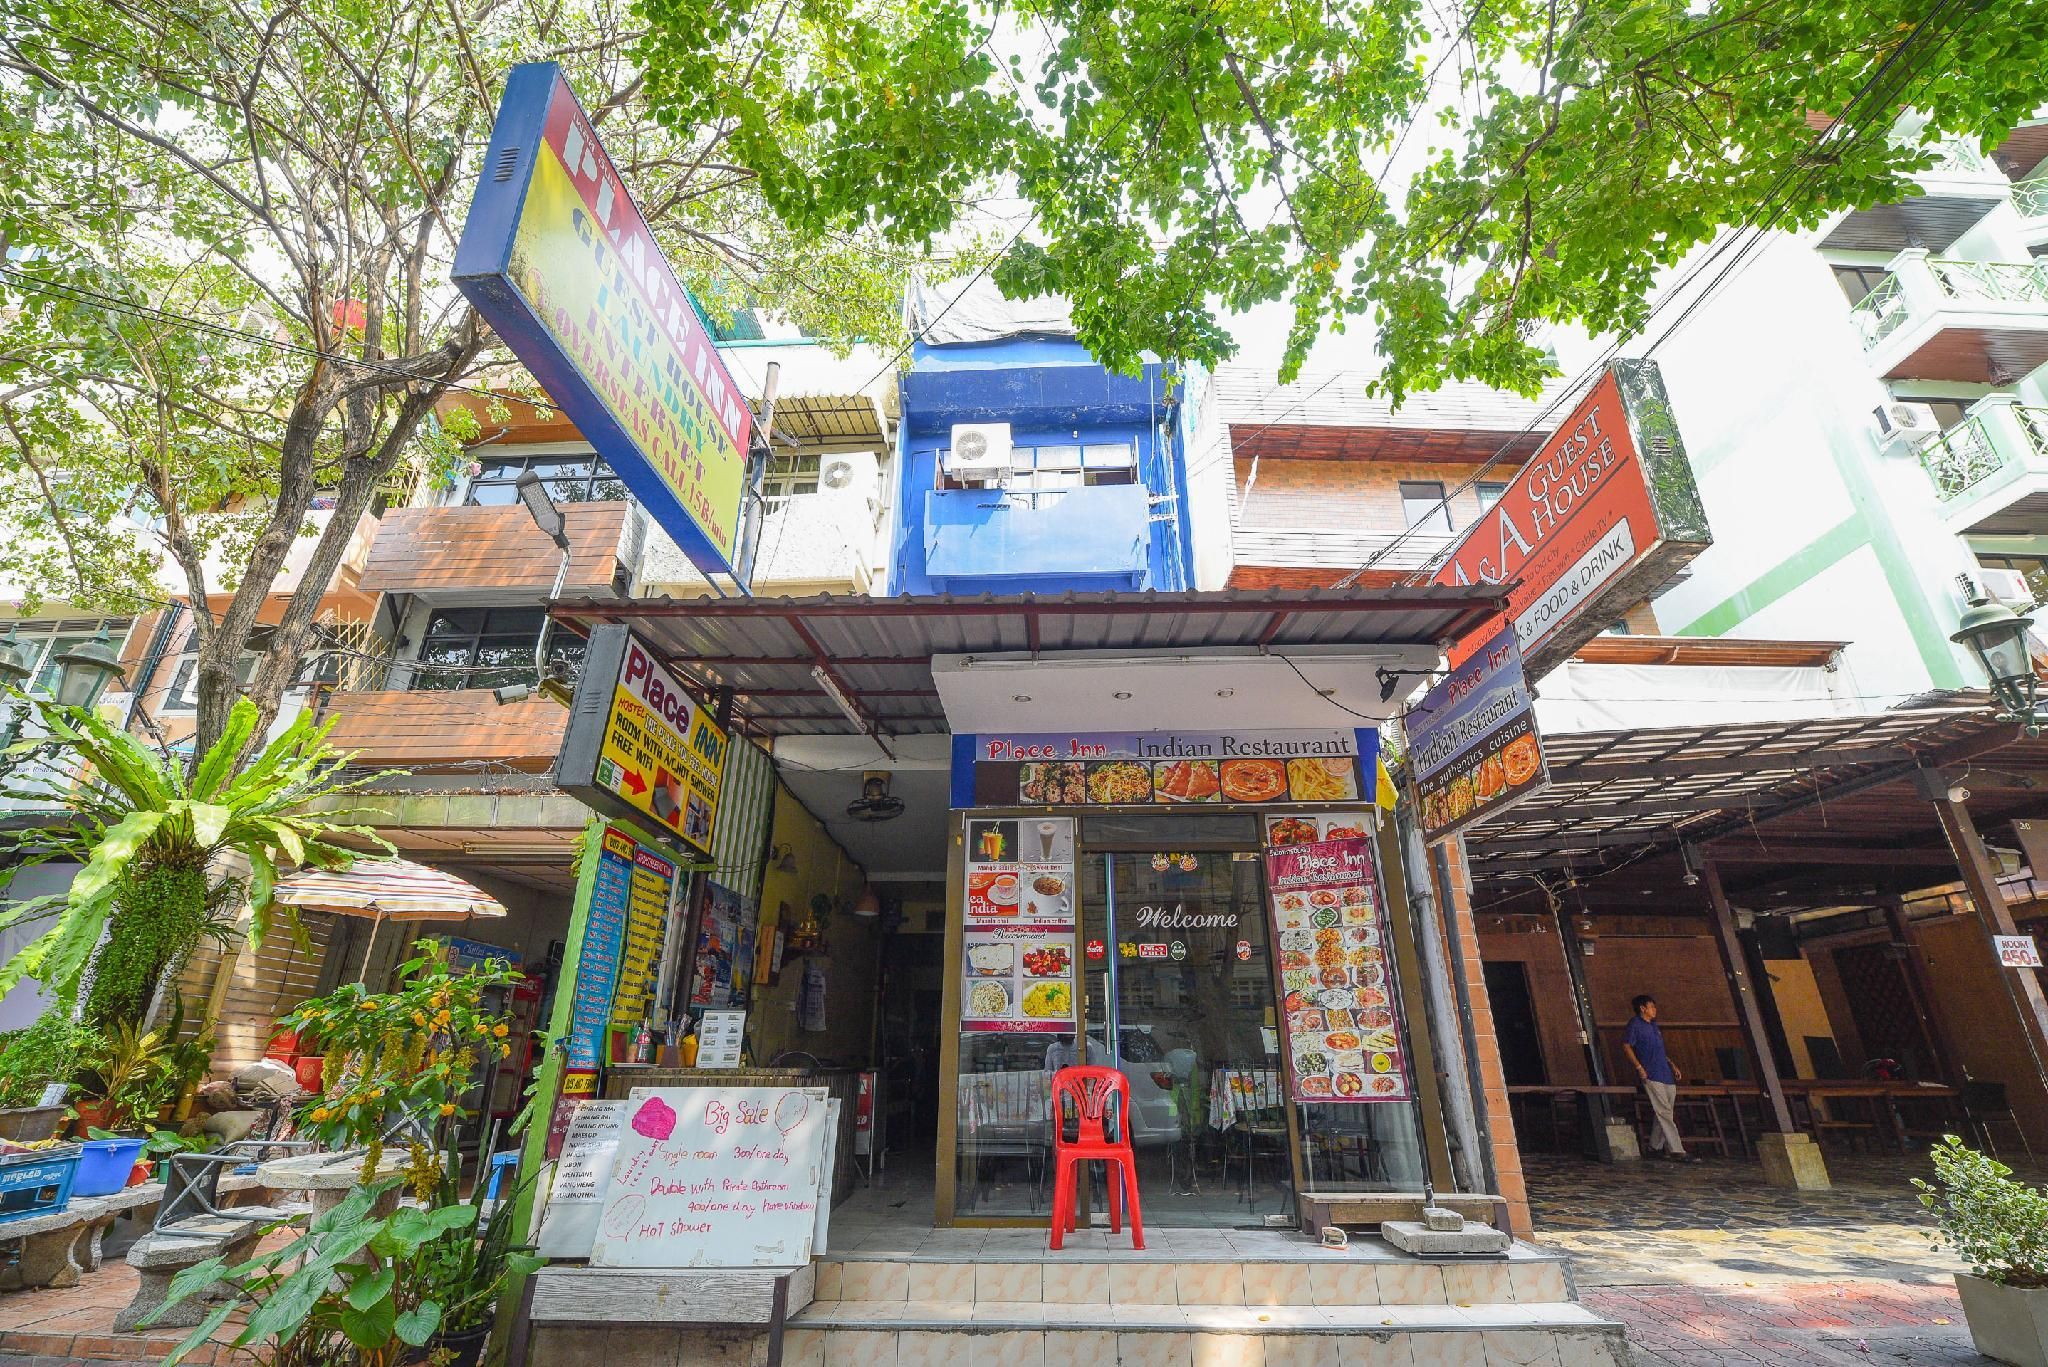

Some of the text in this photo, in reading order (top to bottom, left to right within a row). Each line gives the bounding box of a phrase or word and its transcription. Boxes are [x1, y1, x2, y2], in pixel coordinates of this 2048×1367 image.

[563, 117, 743, 443] PLACE INN
[572, 206, 728, 463] GUEST HOUSE
[597, 282, 707, 455] LAUNDRY
[556, 308, 651, 455] OVERSEAS
[652, 436, 688, 498] CALL
[587, 308, 707, 484] INTERNET
[1527, 406, 1604, 502] GUEST
[1532, 437, 1616, 540] HOUSE
[1534, 586, 1569, 629] FOOD
[1571, 580, 1580, 596] &
[1580, 532, 1625, 587] DRINK
[625, 644, 690, 734] Place
[1448, 643, 1511, 706] Place Inn
[618, 698, 645, 718] HOSTEL
[1415, 727, 1458, 774] Indian
[1458, 686, 1521, 744] Restaurant
[612, 729, 653, 771] FREE WIFI
[615, 712, 642, 741] ROOM
[643, 733, 663, 760] WITH
[691, 774, 715, 801] SHOWER
[693, 722, 723, 768] INN
[985, 735, 1351, 760] Place Inn Indian Restaurant
[1420, 719, 1529, 797] the authentics cuisine
[1277, 869, 1363, 886] Indian Restaurant
[1297, 849, 1366, 870] Place Inn
[968, 894, 985, 905] ea
[1135, 903, 1240, 929] Welcome
[2001, 940, 2029, 949] ROOM
[2001, 949, 2032, 966] 450
[704, 1099, 730, 1135] Big
[735, 1100, 769, 1125] Sale
[692, 1150, 718, 1160] room
[772, 1148, 789, 1167] day
[650, 1176, 687, 1196] Double
[732, 1201, 755, 1219] day
